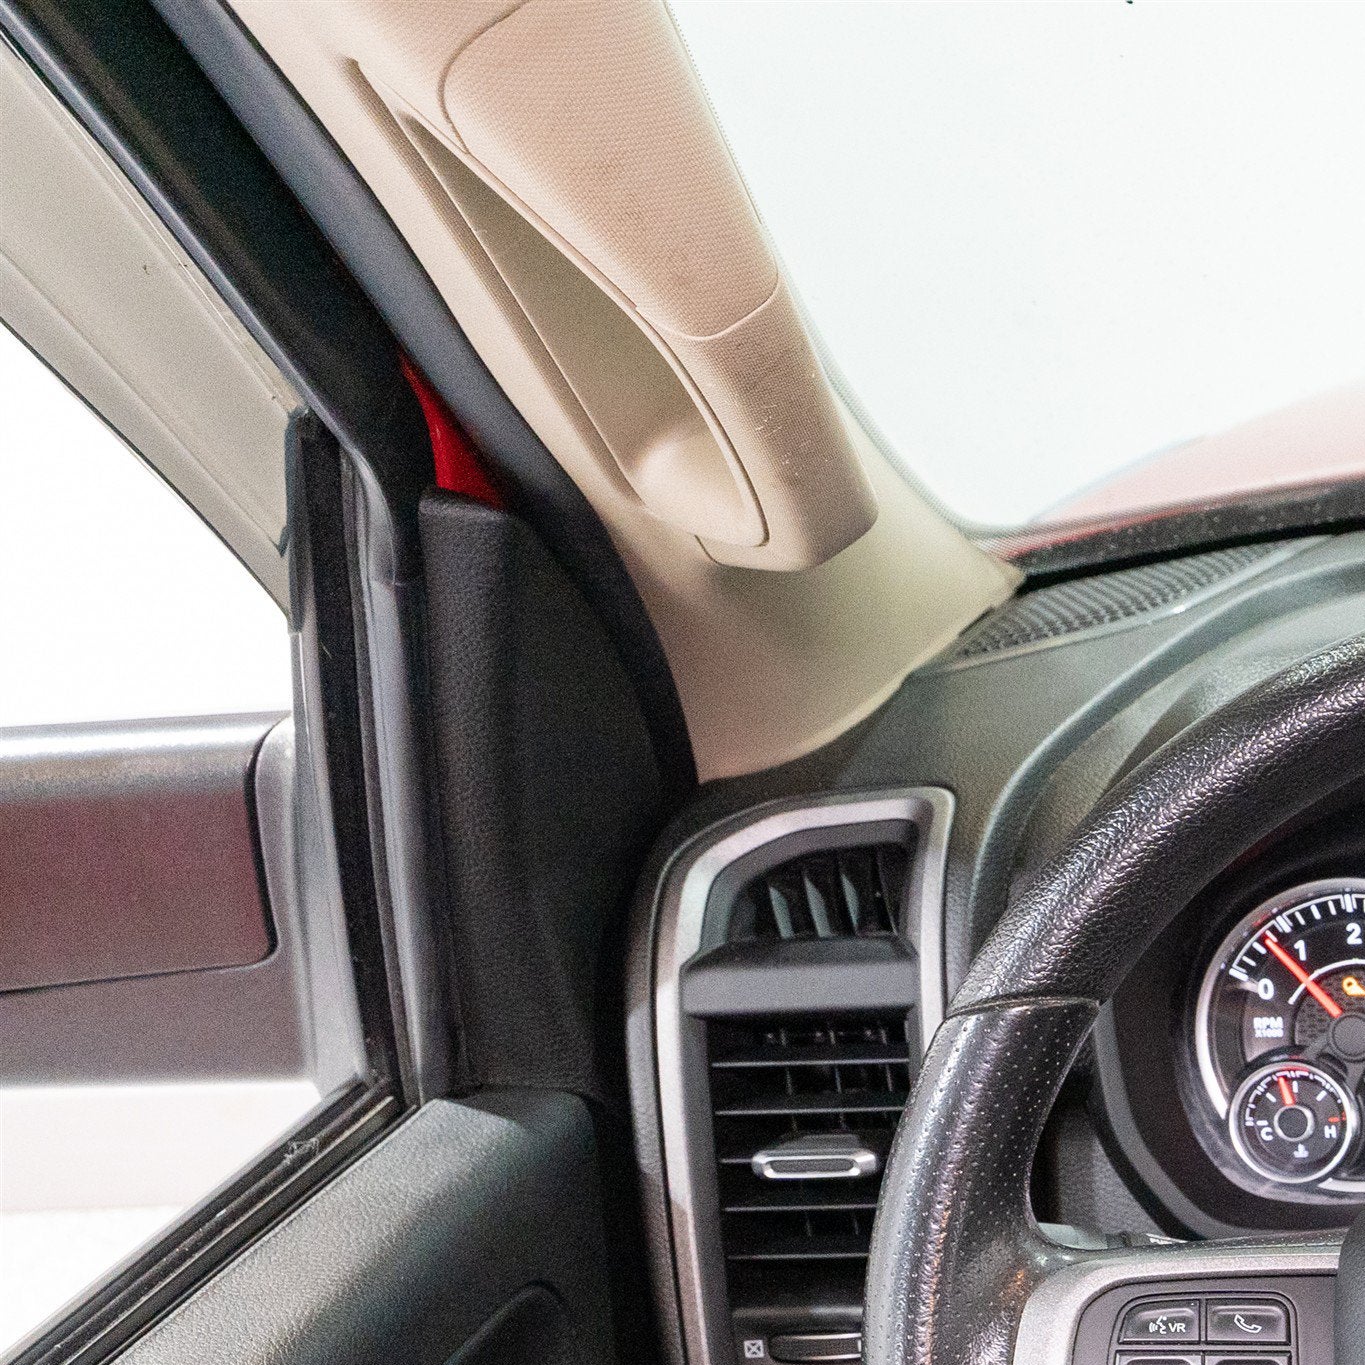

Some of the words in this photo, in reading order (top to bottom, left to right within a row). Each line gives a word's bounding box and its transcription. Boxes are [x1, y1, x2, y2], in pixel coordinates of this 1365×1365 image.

[1346, 923, 1363, 945] 2
[1293, 939, 1307, 961] 1
[1257, 977, 1275, 1001] 0
[1260, 1127, 1274, 1141] C
[1324, 1125, 1337, 1139] H
[1168, 1322, 1186, 1333] VR
